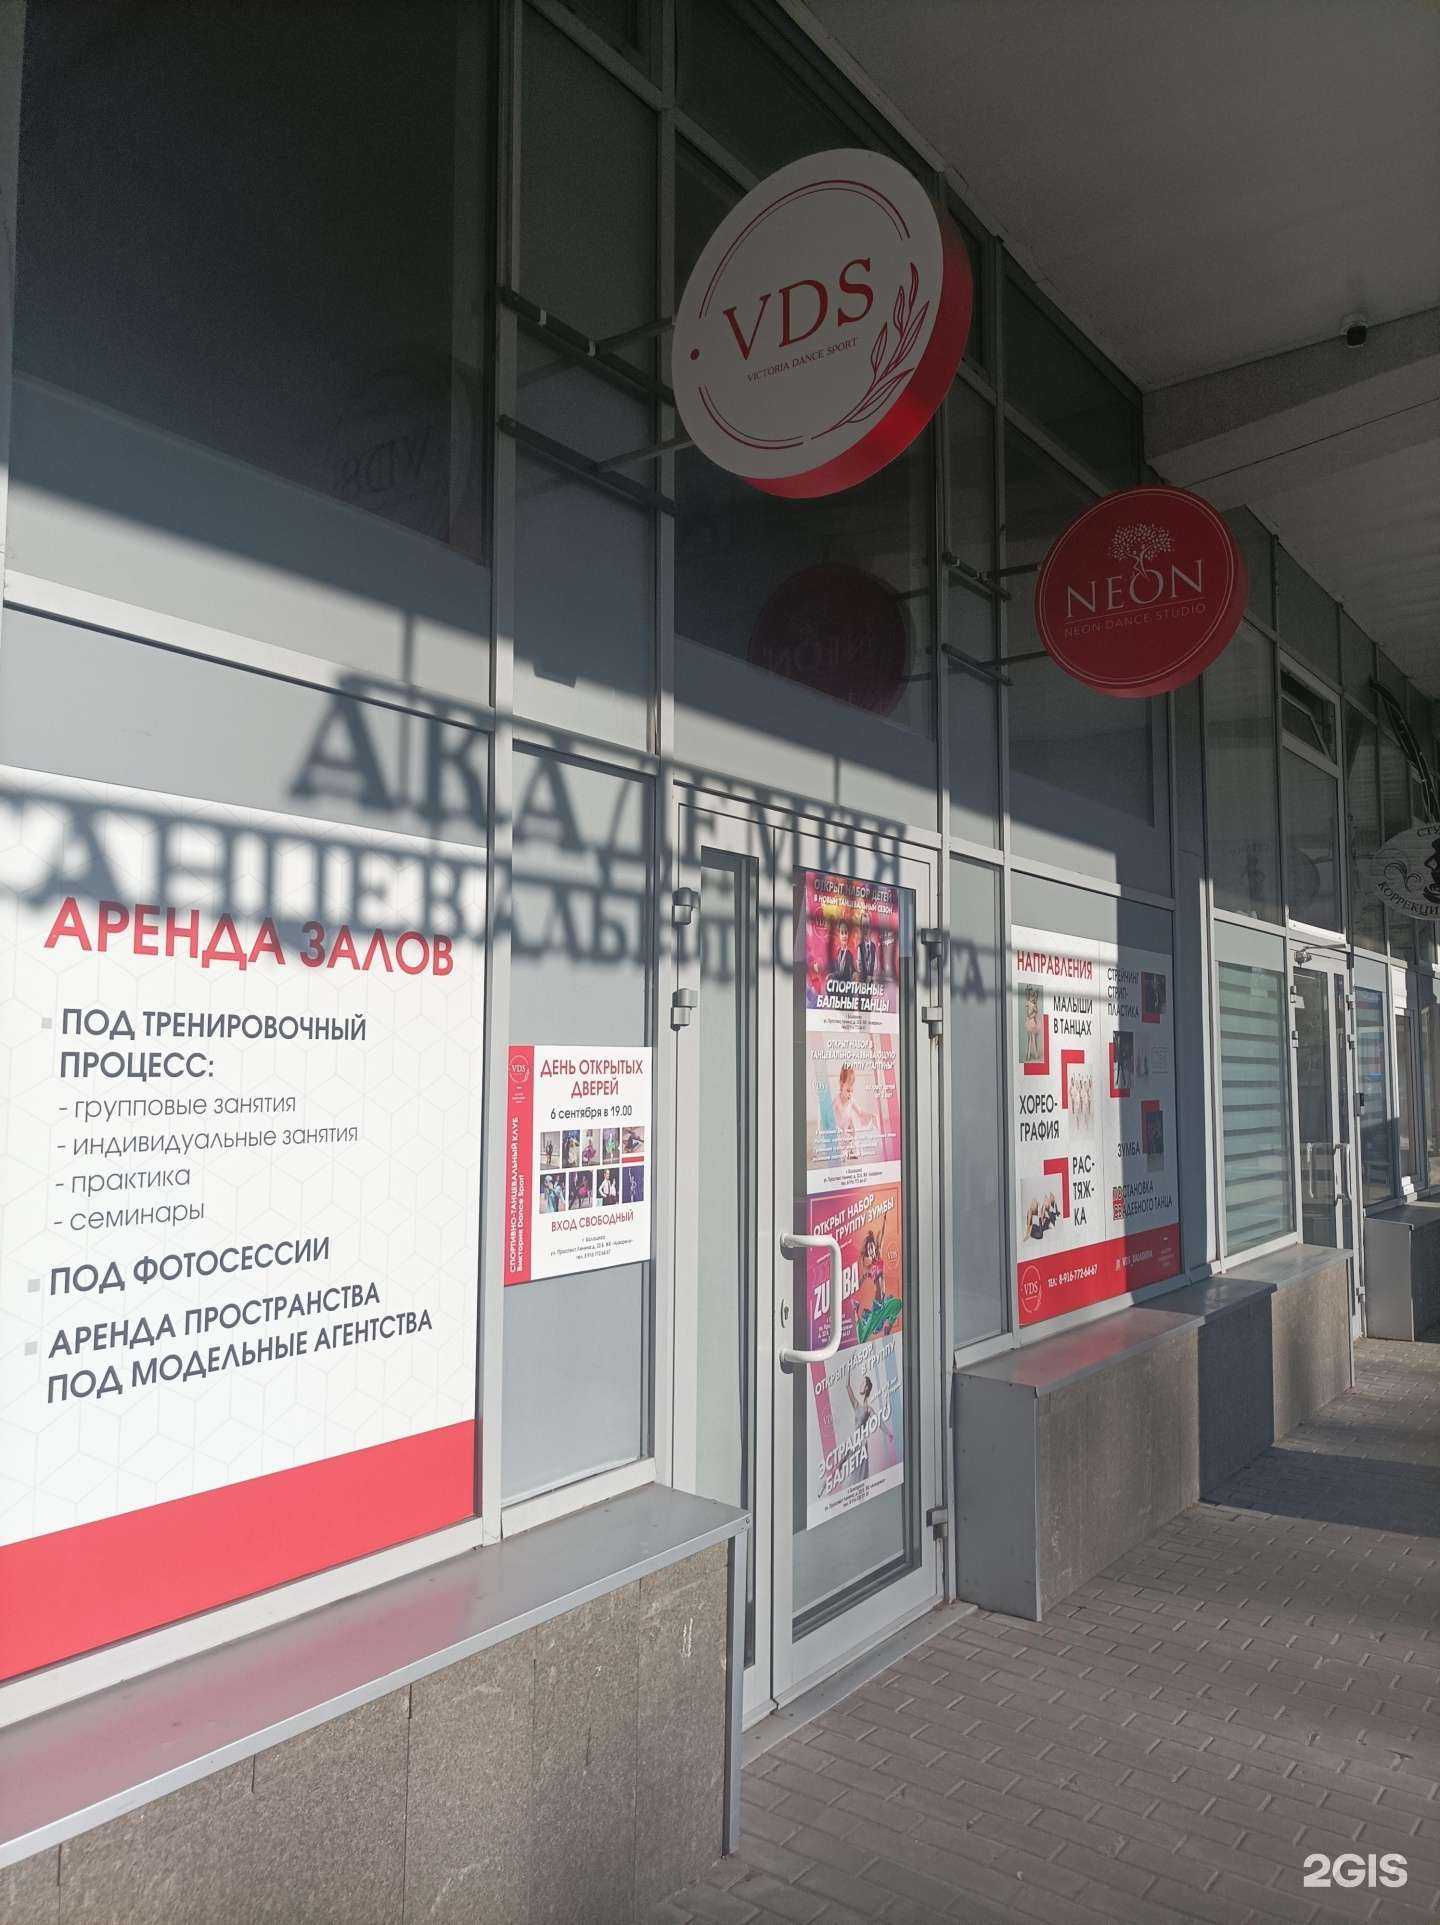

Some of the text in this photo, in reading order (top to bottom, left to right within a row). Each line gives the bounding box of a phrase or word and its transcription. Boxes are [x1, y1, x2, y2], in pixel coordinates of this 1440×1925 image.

[722, 256, 875, 362] VDS
[746, 337, 859, 382] VICTORIA DANCE SPORT
[1065, 559, 1206, 618] NEON
[1064, 602, 1207, 640] NEON DANCE STUDIO
[44, 895, 454, 977] АРЕНДА ЗАЛОВ
[1016, 949, 1093, 980] НАПРАВЛЕНИЯ
[826, 979, 884, 996] СПОРТИВНЫЕ
[816, 994, 890, 1014] БАЛЬНЫЕ ТАНЦЫ
[1053, 995, 1093, 1015] МАЛЫШИ
[62, 1007, 367, 1041] ПОД ТРЕНИРОВОЧНЫЙ
[1053, 1018, 1092, 1038] В ТАНЦАХ
[60, 1050, 215, 1081] ПРОЦЕСС:
[540, 1059, 643, 1078] ДЕНЬ ОТКРЫТЫХ
[571, 1078, 619, 1098] ДВЕРЕЙ
[74, 1096, 207, 1123] групповые
[213, 1093, 297, 1115] занятия
[550, 1104, 633, 1120] 6 сентября в 19.00
[1020, 1094, 1058, 1115] ХОРЕО-
[73, 1126, 276, 1157] индивидуальные
[281, 1125, 359, 1147] занятия
[1020, 1119, 1059, 1142] ГРАФИЯ
[1117, 1141, 1141, 1158] ЗУМБА
[1073, 1156, 1095, 1175] РАС-
[71, 1166, 191, 1197] практика
[1073, 1181, 1095, 1201] ТЯЖ-
[70, 1202, 205, 1231] семинары
[551, 1209, 634, 1232] ВХОД СВОБОДНЫЙ
[813, 1193, 875, 1236] ОТКРЫТ НАБОР
[835, 1196, 894, 1243] ГРУППУ ЗУМБЫ
[1074, 1206, 1087, 1227] КА
[50, 1237, 331, 1295] ПОД ФОТОСЕССИИ
[813, 1260, 860, 1321] ZUBA
[1024, 1281, 1039, 1295] VDS
[48, 1282, 381, 1358] АРЕНДА ПРОСТРАНСТВА
[47, 1309, 433, 1403] ПОД МОДЕЛЬНЫЕ АГЕНТСТВА
[818, 1404, 891, 1479] ЭСТРАДНОГО
[824, 1448, 869, 1495] БАЛЕТА
